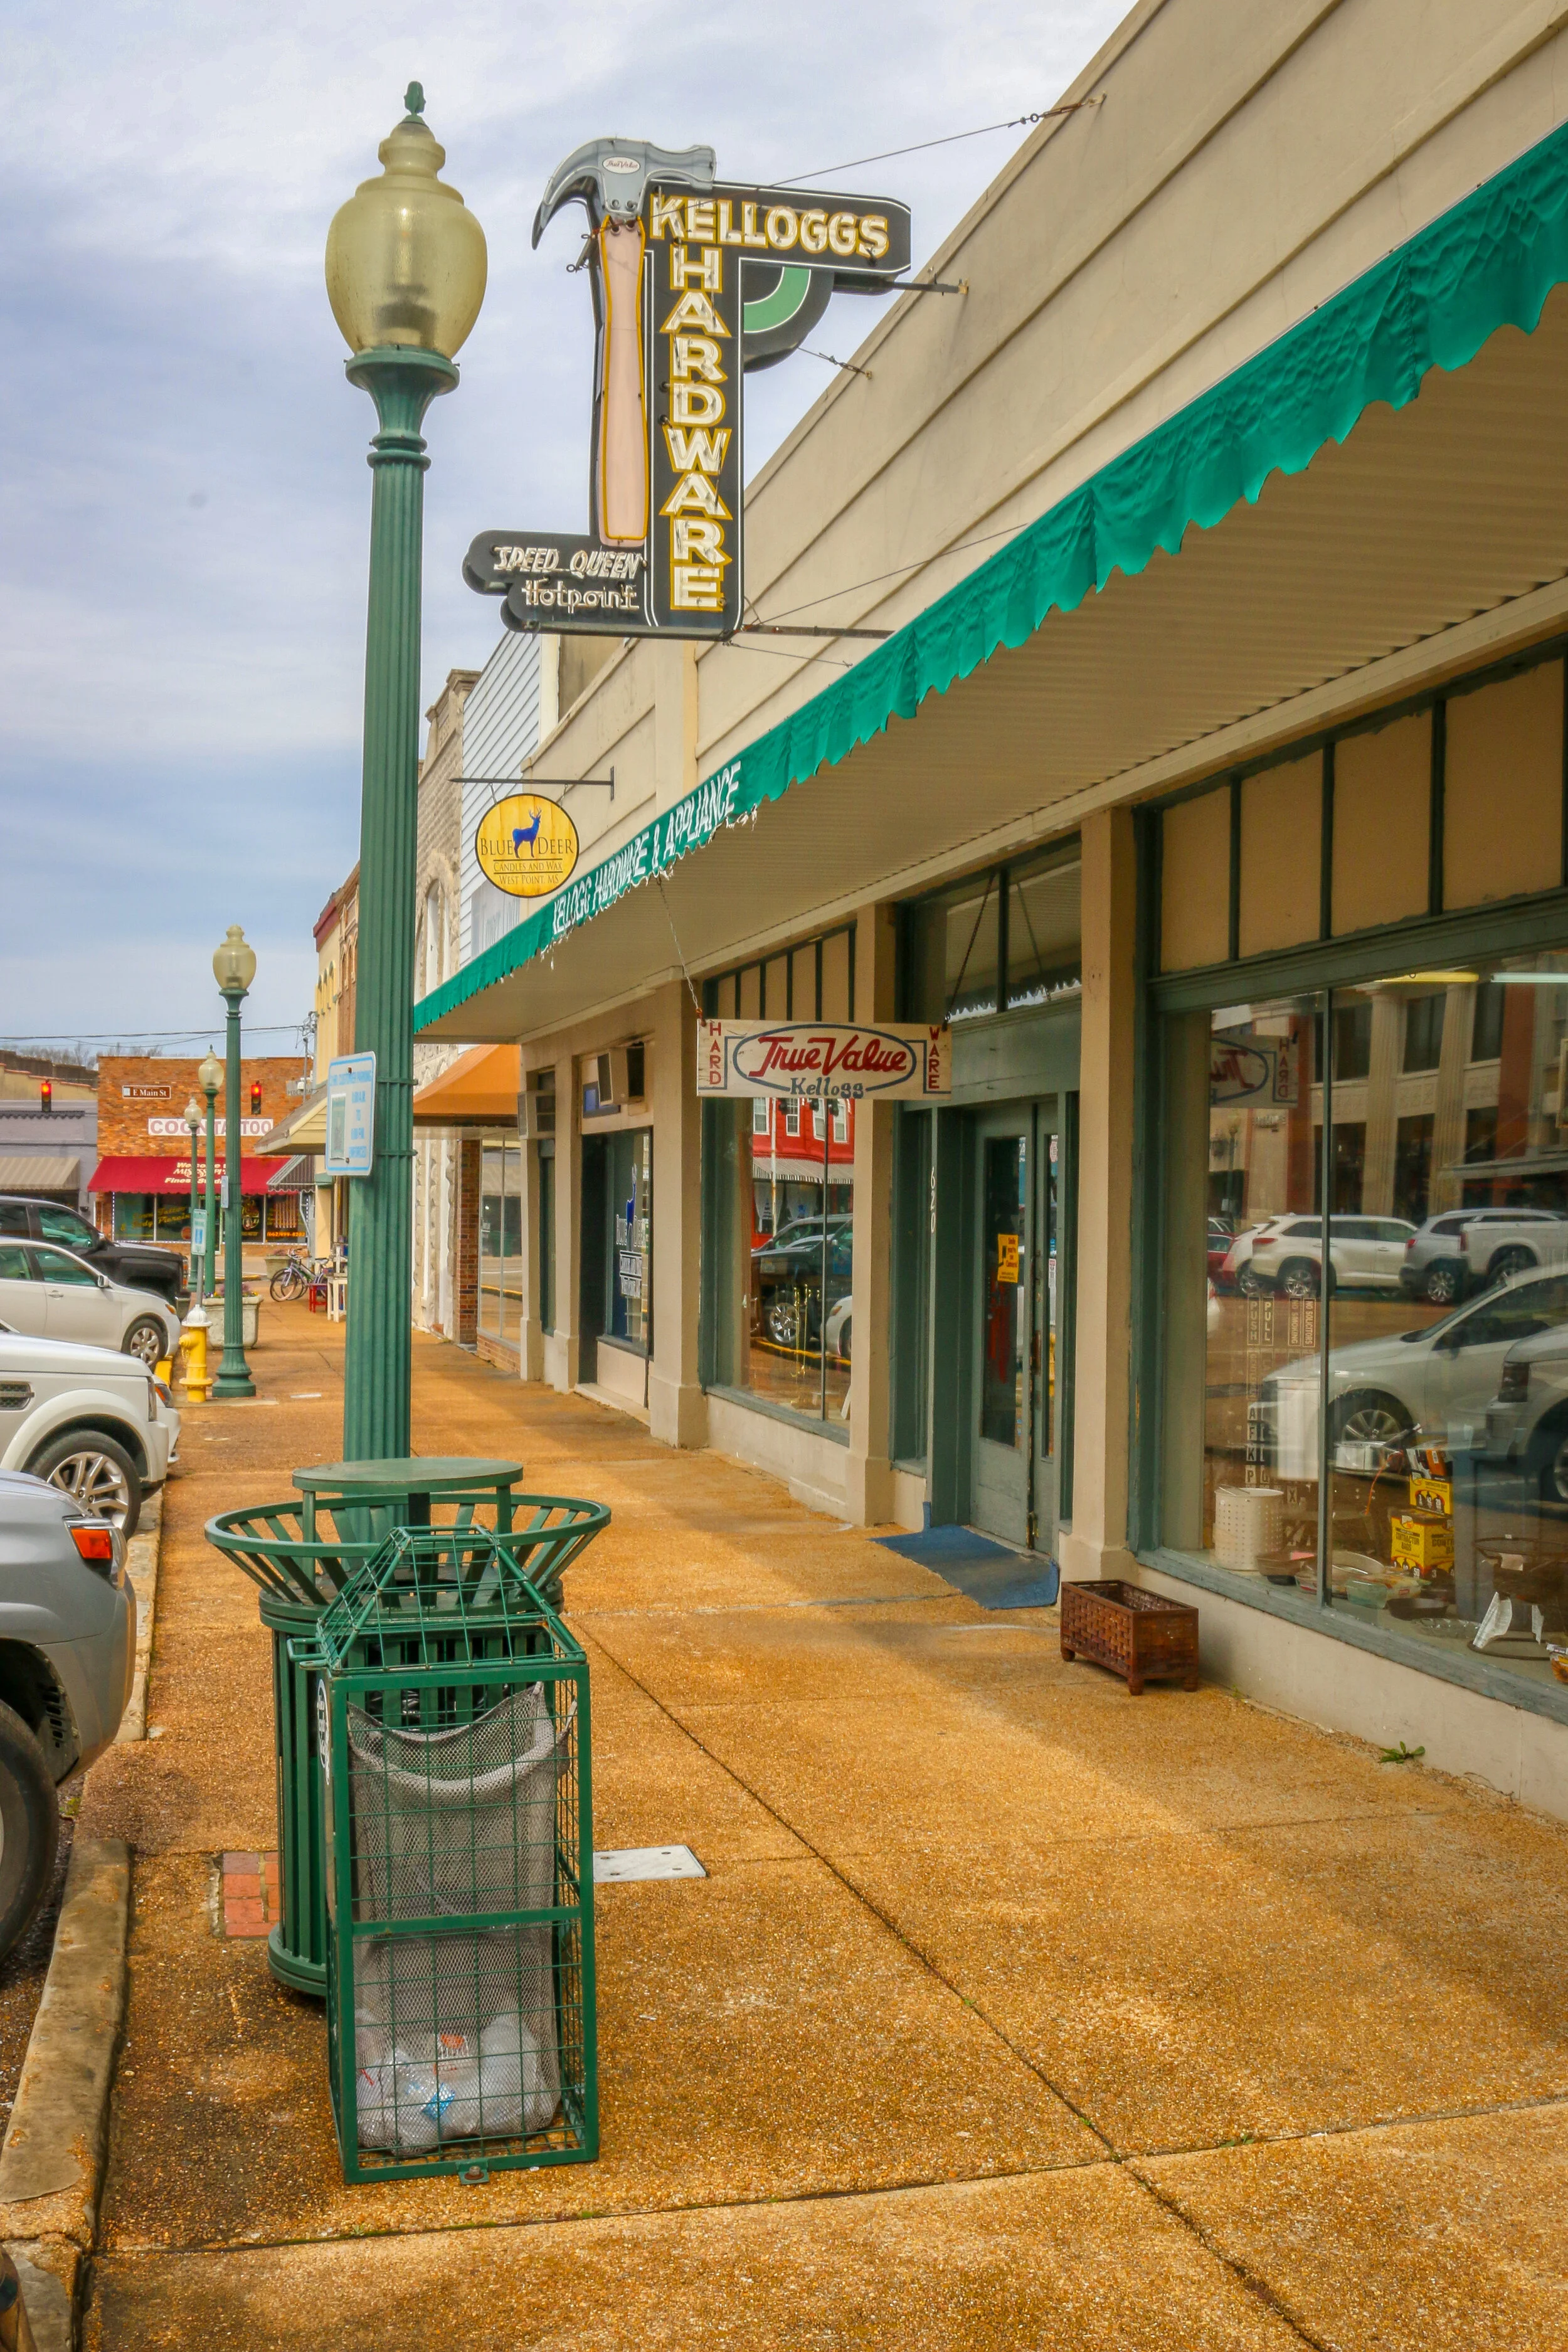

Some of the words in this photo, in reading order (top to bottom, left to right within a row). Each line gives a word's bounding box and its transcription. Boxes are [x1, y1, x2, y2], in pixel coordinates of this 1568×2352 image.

[650, 193, 889, 258] KELLOGGS
[659, 246, 733, 612] HARDWARE
[494, 546, 559, 573] SPEED
[569, 549, 642, 580] QUEEN
[521, 580, 640, 614] Hotpoint
[480, 838, 514, 856] BLUE
[538, 837, 574, 854] DEER
[592, 831, 650, 910] HARDWARE
[663, 760, 741, 861] APPLIANCE
[493, 862, 526, 872] CANDLES
[529, 862, 544, 871] AND
[546, 861, 563, 871] WAX
[499, 875, 519, 885] WEST
[548, 874, 559, 884] MS
[709, 1022, 722, 1085] HARD
[748, 1036, 822, 1078] True
[807, 1034, 907, 1076] Value
[928, 1027, 940, 1089] WARE
[790, 1077, 864, 1099] Kellogg
[150, 1120, 207, 1135] COON
[214, 1120, 272, 1135] TTOO
[1305, 1300, 1313, 1310] NO
[1291, 1312, 1299, 1345] SMOKING
[1305, 1311, 1313, 1345] SOLICITORS
